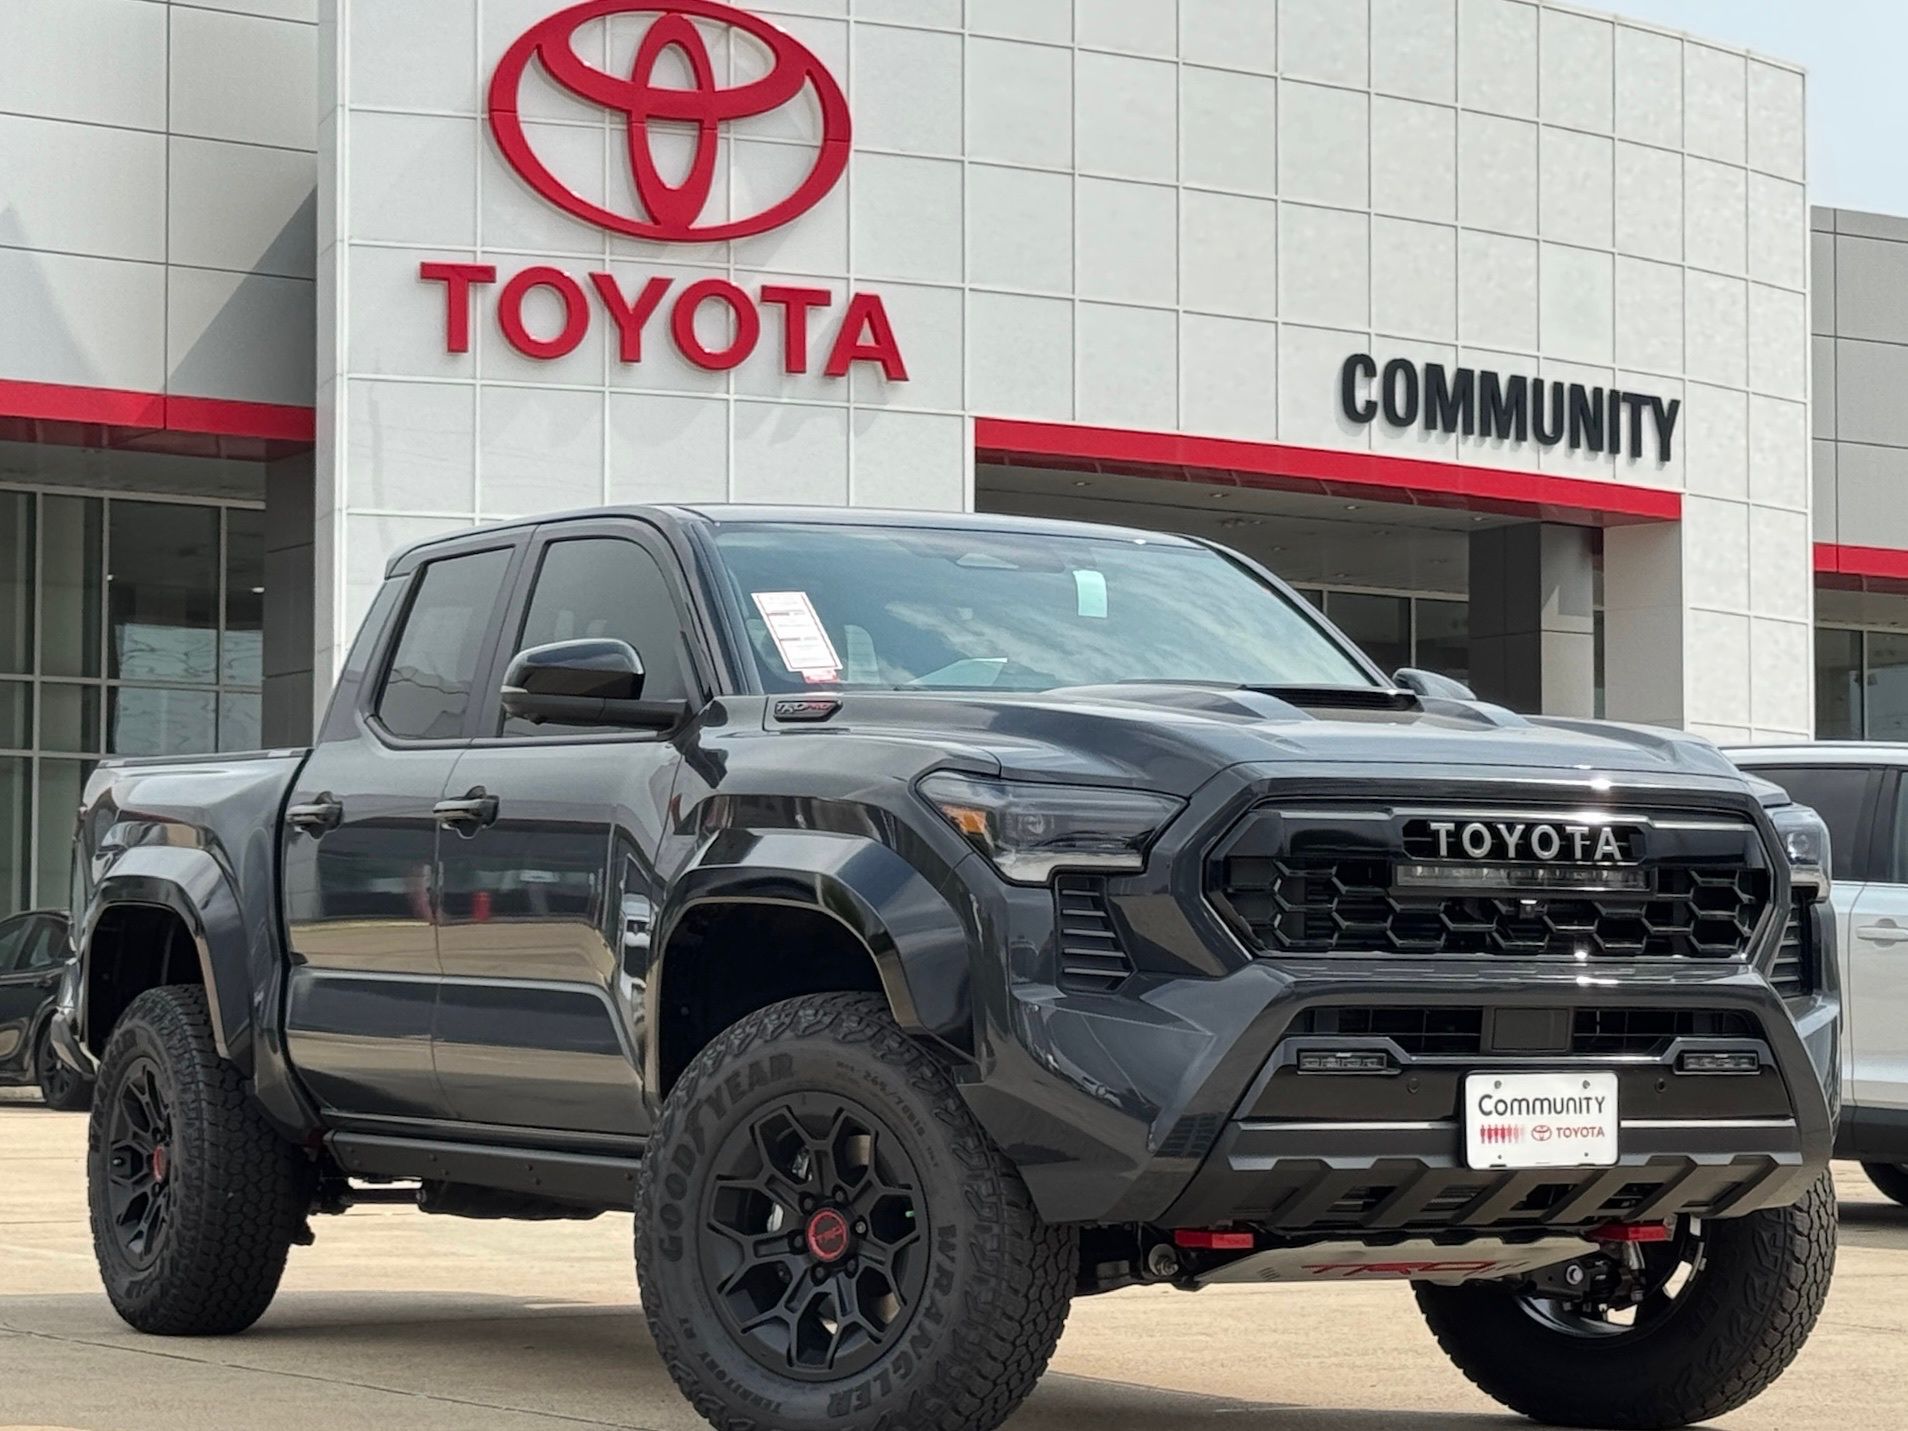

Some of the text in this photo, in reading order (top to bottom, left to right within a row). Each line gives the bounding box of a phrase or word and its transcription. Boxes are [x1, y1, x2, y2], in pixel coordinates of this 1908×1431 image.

[420, 261, 910, 382] TOYOTA
[1342, 353, 1681, 462] COMMUNITY
[1428, 821, 1623, 860] TOYOTA
[658, 1052, 796, 1262] GOODYEAR
[1556, 1127, 1606, 1138] TOYOTA
[827, 1224, 958, 1418] WRANGLER
